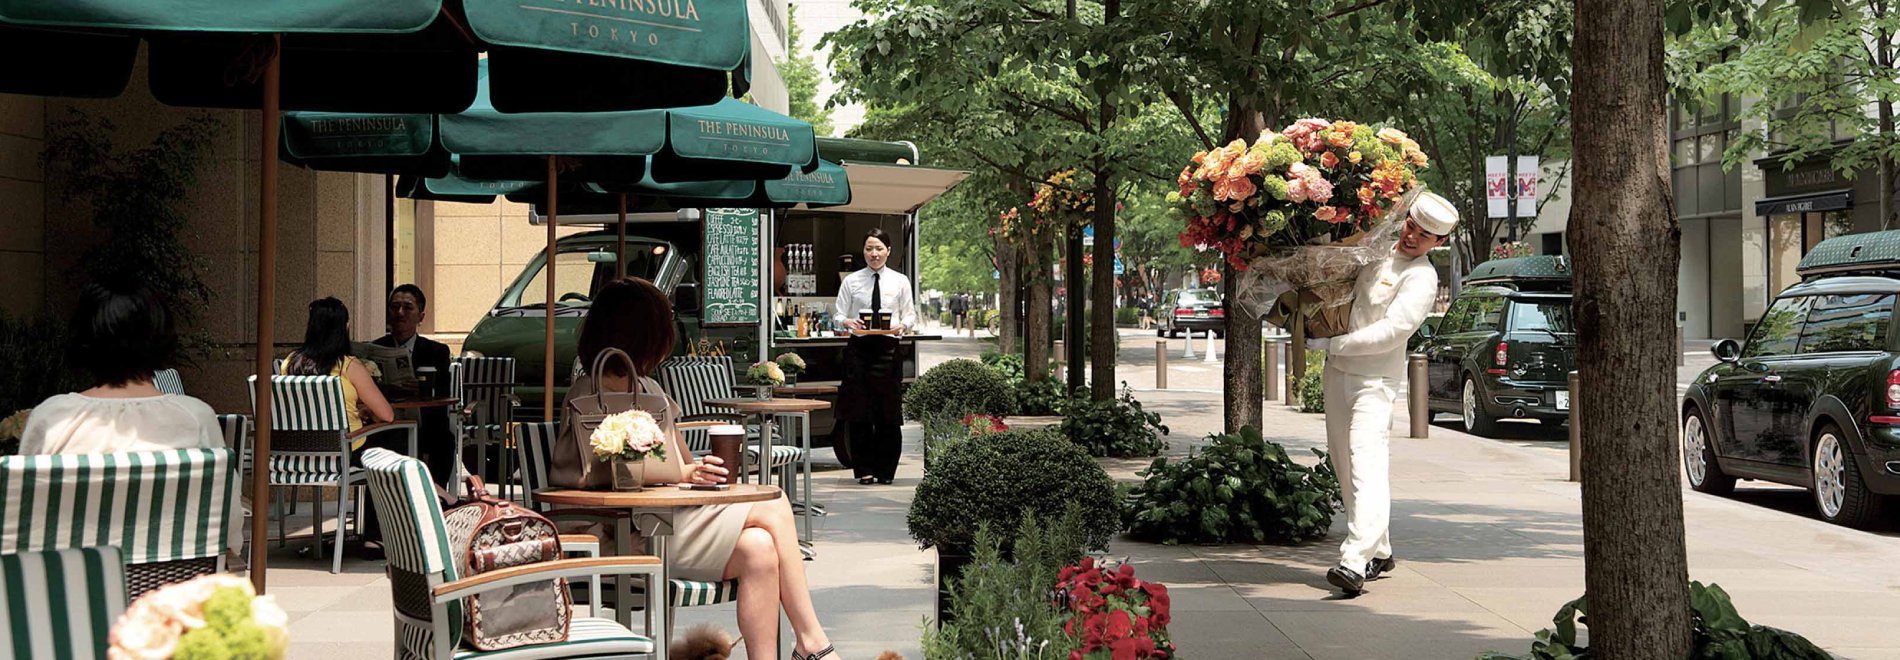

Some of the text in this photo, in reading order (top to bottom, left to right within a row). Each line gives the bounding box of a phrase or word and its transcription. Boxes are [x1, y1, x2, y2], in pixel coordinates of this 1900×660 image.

[576, 0, 700, 21] NSULA
[571, 22, 658, 46] TOKYO
[310, 117, 406, 133] THE PENINSULA
[698, 120, 790, 141] THE PENINSULA
[723, 143, 768, 155] TOKYO
[796, 170, 834, 184] PENINSULA
[480, 182, 524, 190] TOKYO
